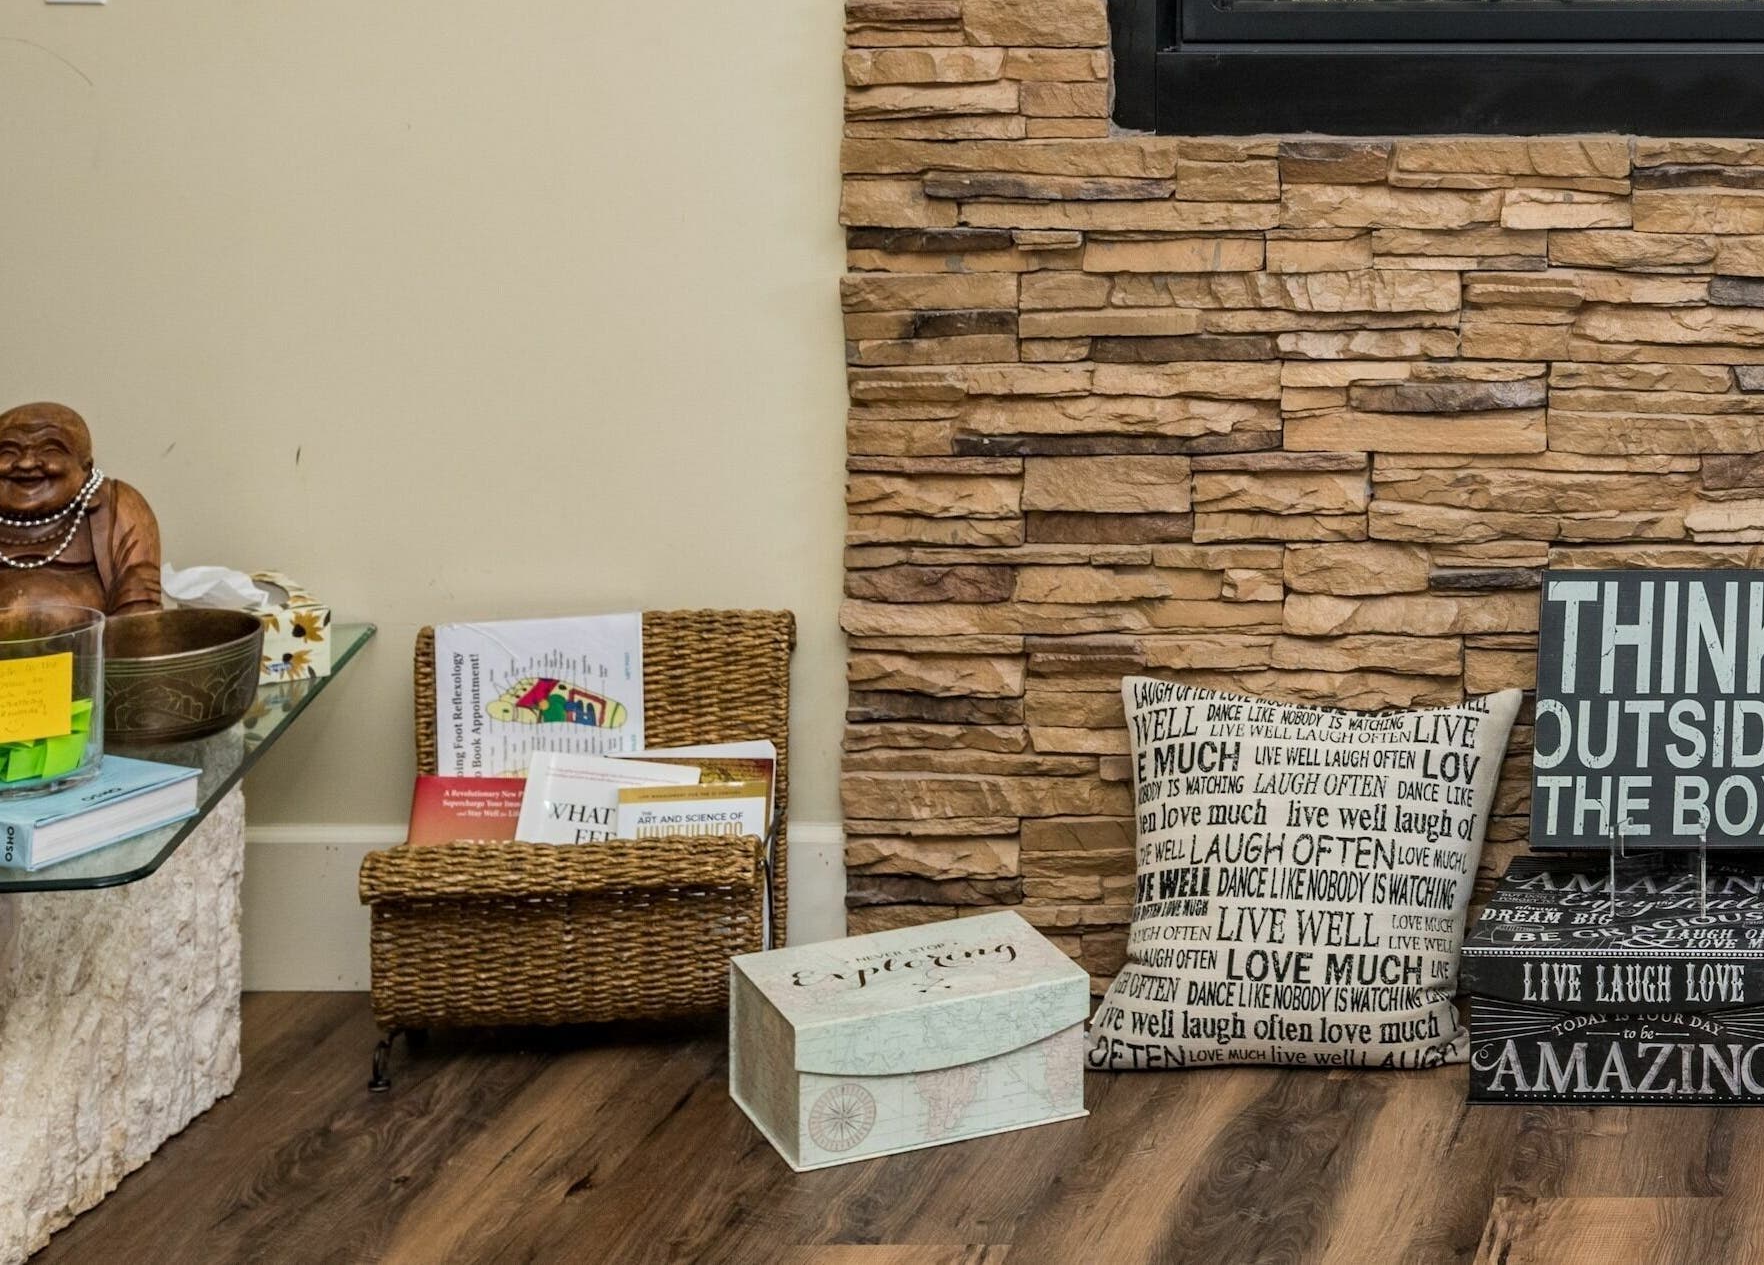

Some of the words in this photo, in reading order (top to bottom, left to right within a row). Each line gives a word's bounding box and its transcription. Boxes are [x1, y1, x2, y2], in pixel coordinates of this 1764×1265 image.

[451, 652, 465, 721] Reflexology
[469, 653, 483, 735] Appointment!
[452, 725, 464, 749] Foot
[1135, 705, 1198, 746] WELL
[1206, 703, 1241, 723] DANCE
[1247, 706, 1275, 724] LIKE
[1281, 708, 1323, 728] NOBODY
[1348, 715, 1405, 733] WATCHING
[1413, 714, 1480, 750] LIVE
[470, 738, 482, 768] Book
[1154, 741, 1240, 777] MUCH
[1286, 747, 1321, 767] WELL
[1325, 748, 1369, 769] LAUGH
[1373, 749, 1416, 771] OFTEN
[1253, 773, 1321, 797] LAUGH
[1324, 774, 1390, 800] OFTEN
[1397, 781, 1439, 803] DANCE
[1446, 785, 1475, 808] LIKE
[1537, 776, 1652, 836] THE
[549, 802, 617, 825] WHAT
[637, 816, 657, 824] ART
[661, 814, 682, 823] AND
[685, 813, 726, 822] SCIENCE
[730, 811, 743, 820] OF
[1160, 803, 1201, 829] love
[1208, 797, 1268, 827] much
[1288, 798, 1329, 828] live
[1339, 803, 1388, 833] well
[1394, 804, 1453, 840] laugh
[5, 826, 15, 862] OSHO
[1189, 833, 1285, 865] LAUGH
[1291, 833, 1397, 871] OFTEN
[1158, 867, 1212, 900] WELL
[1216, 866, 1266, 898] DANCE
[1270, 868, 1304, 900] LIKE
[1306, 871, 1366, 906] NOBODY
[1216, 905, 1287, 944] LIVE
[1298, 909, 1380, 947] WELL
[1480, 908, 1563, 924] DREAM
[1571, 912, 1615, 925] BIG
[1512, 932, 1561, 942] BE
[1572, 911, 1764, 939] GRACIOUS
[1664, 929, 1735, 940] LAUGH
[1684, 938, 1738, 949] LOVE
[1226, 948, 1313, 983] LOVE
[1324, 953, 1423, 986] MUCH
[1522, 962, 1582, 1002] LIVE
[1595, 962, 1672, 1003] LAUGH
[1685, 962, 1745, 1003] LOVE
[1181, 1010, 1246, 1045] laugh
[1253, 1012, 1314, 1044] often
[1318, 1016, 1373, 1044] love
[1379, 1010, 1440, 1045] much
[1551, 1013, 1608, 1036] TODAY
[1689, 1015, 1725, 1037] DAY
[1623, 1026, 1637, 1039] to
[1640, 1024, 1655, 1040] be
